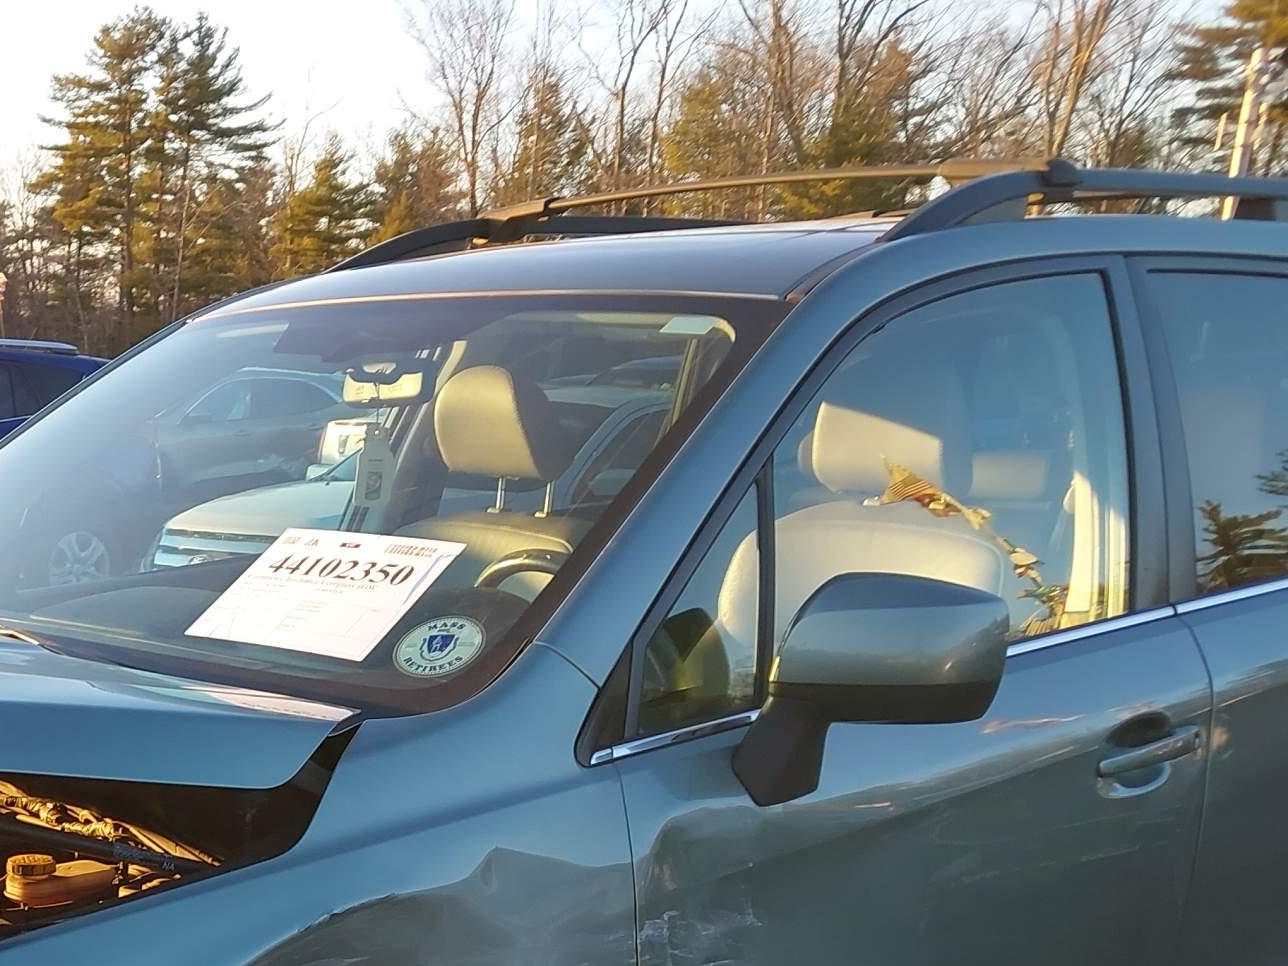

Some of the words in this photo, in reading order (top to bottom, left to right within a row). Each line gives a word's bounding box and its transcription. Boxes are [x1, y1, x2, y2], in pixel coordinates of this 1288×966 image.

[269, 553, 415, 586] 44102350
[428, 621, 466, 631] MASS
[403, 656, 463, 672] RETIREES
